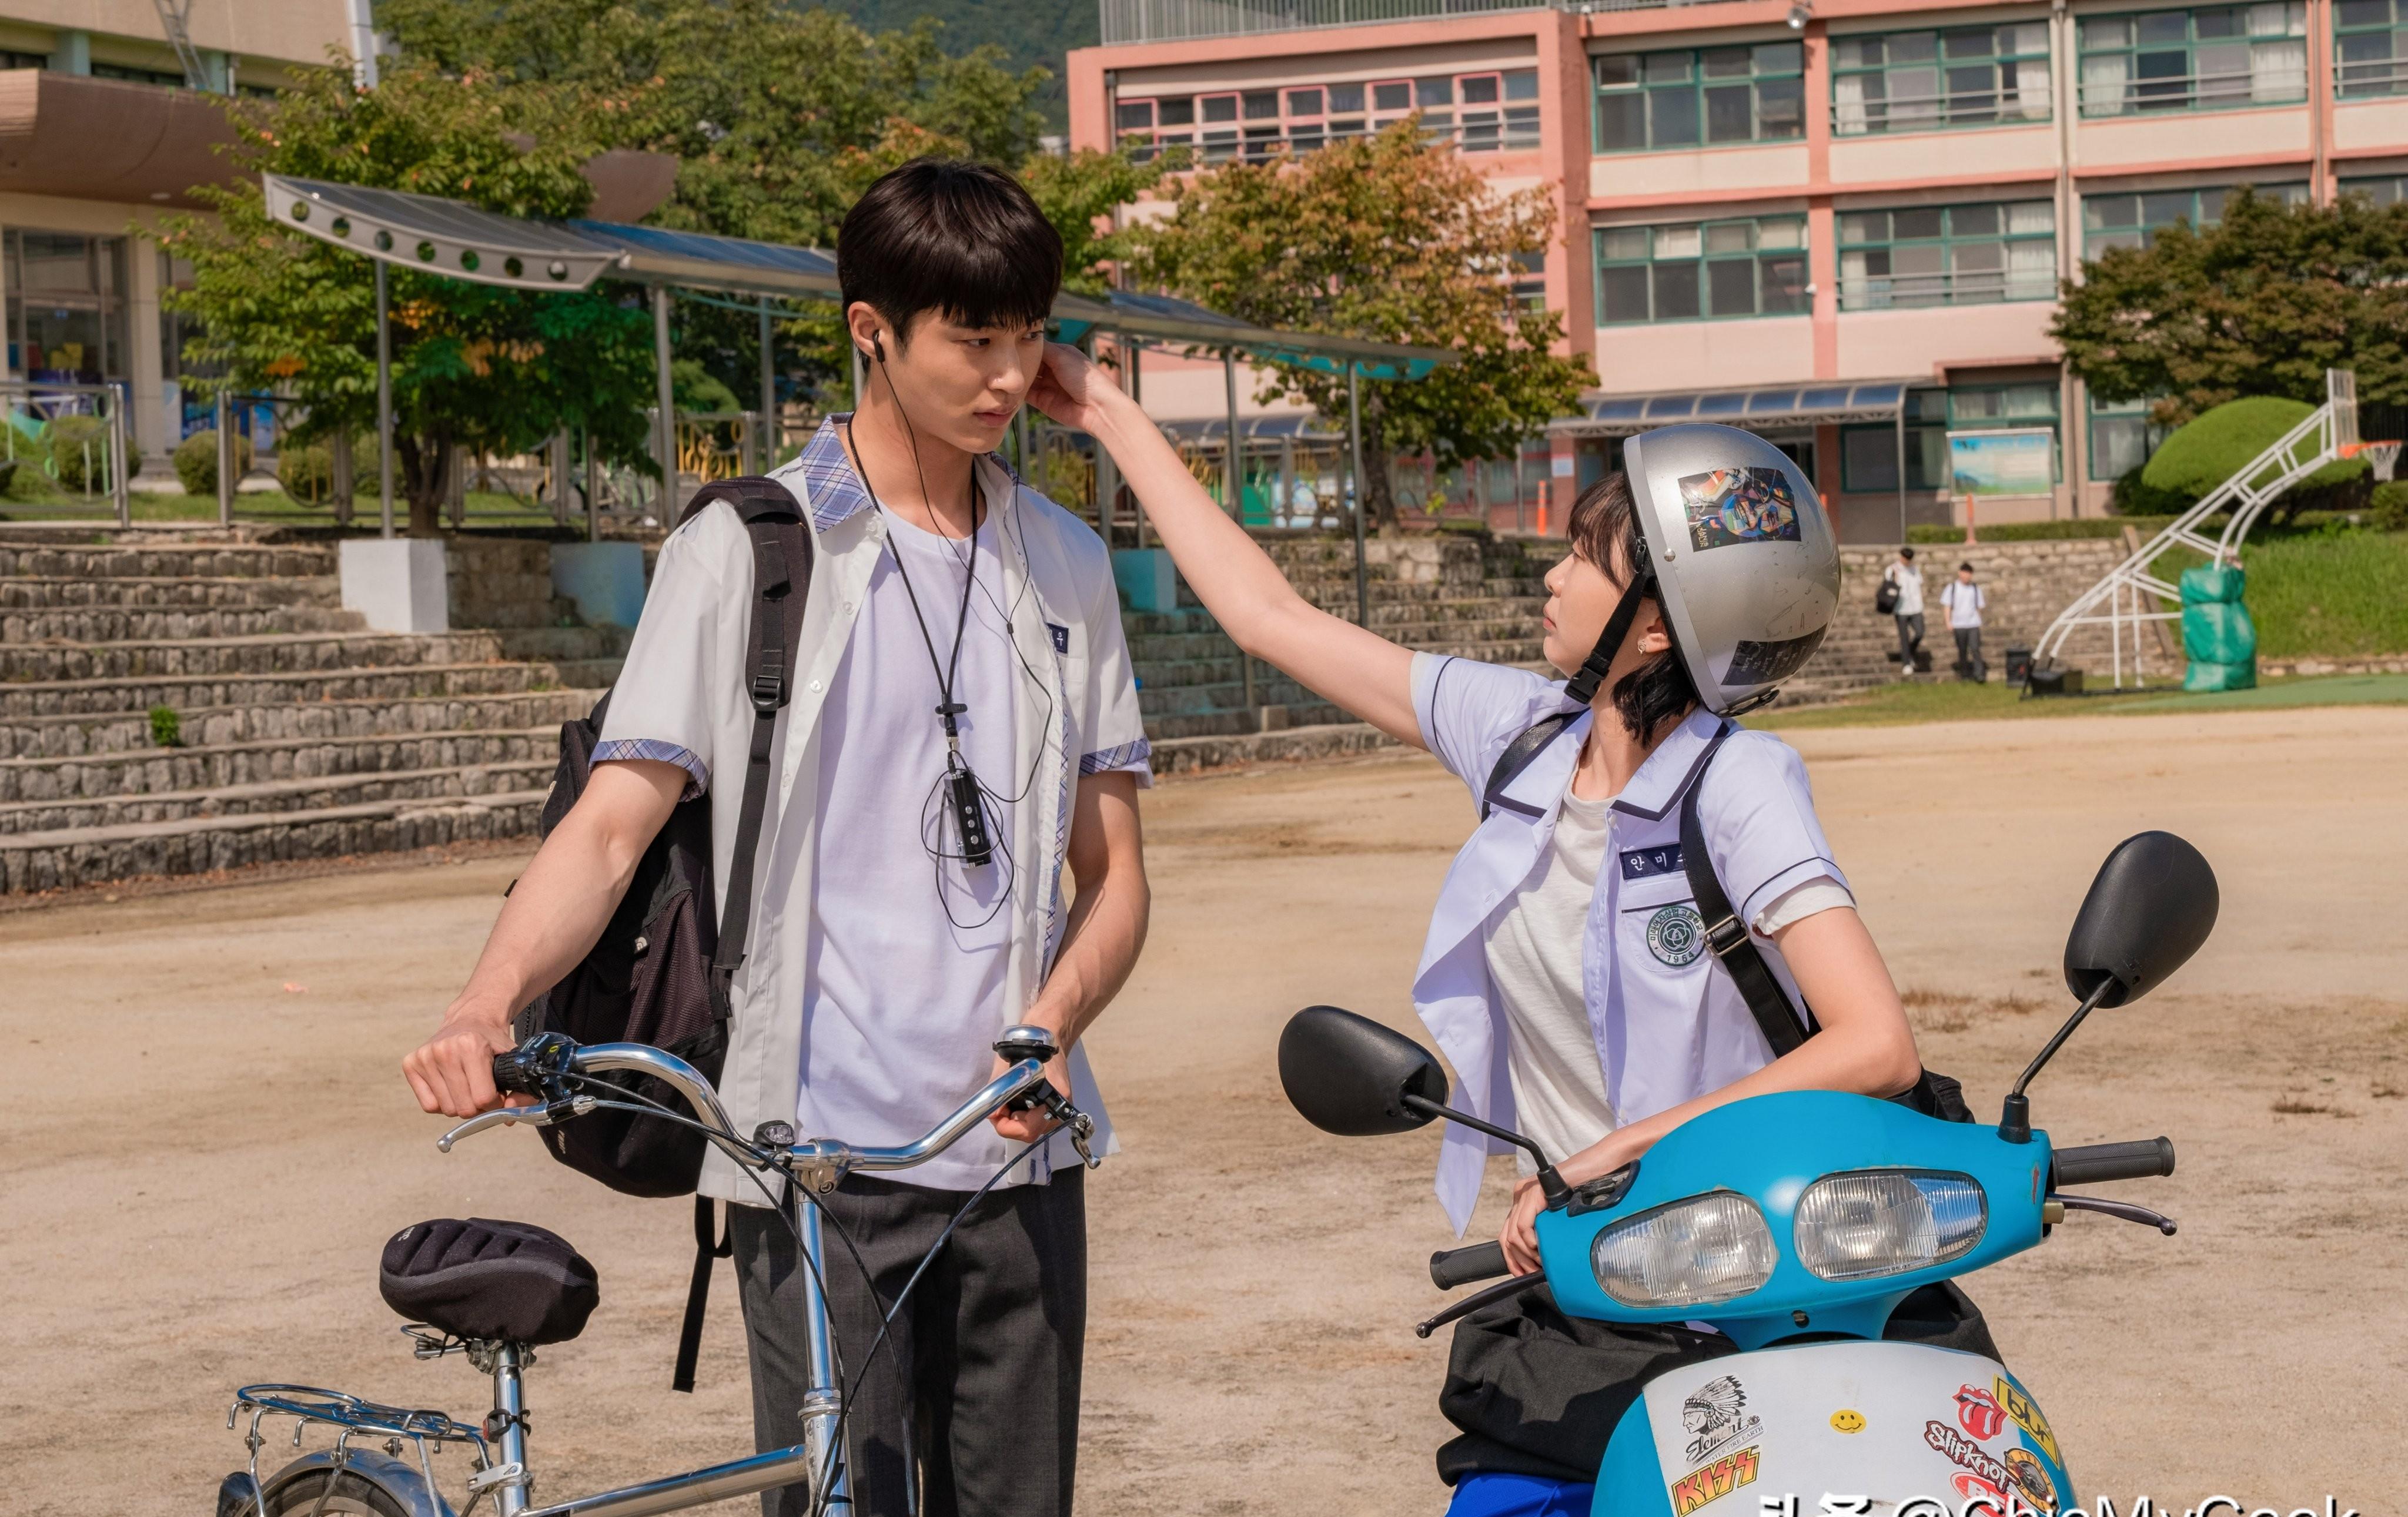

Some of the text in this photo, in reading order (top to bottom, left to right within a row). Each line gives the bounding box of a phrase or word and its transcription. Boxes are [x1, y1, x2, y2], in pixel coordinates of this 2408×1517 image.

[1667, 951, 1694, 963] 1964
[1727, 1439, 1741, 1451] FIRE
[1742, 1426, 1764, 1441] EARTH
[1673, 1448, 1759, 1516] KISS
